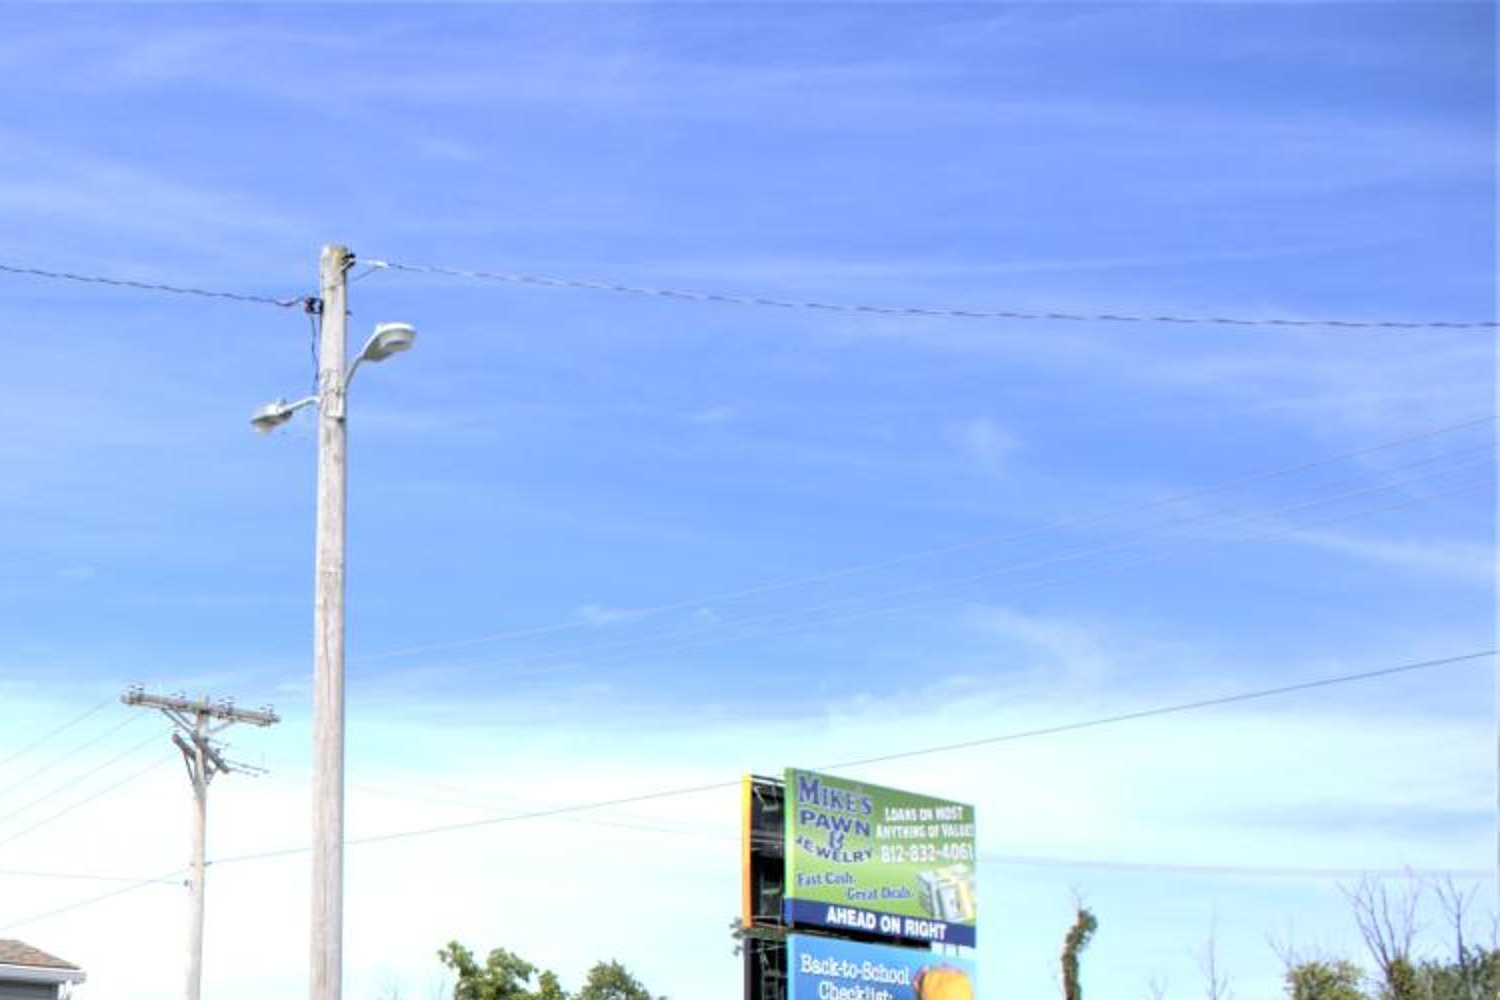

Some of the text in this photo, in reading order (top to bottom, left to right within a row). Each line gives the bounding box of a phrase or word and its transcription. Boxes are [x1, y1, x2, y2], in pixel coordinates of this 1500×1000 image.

[800, 810, 871, 837] PAWN
[796, 834, 873, 863] JEWELRY
[847, 887, 878, 901] Great
[826, 905, 947, 941] AHEAD ON RIGHT
[800, 953, 910, 985] Back-to-School
